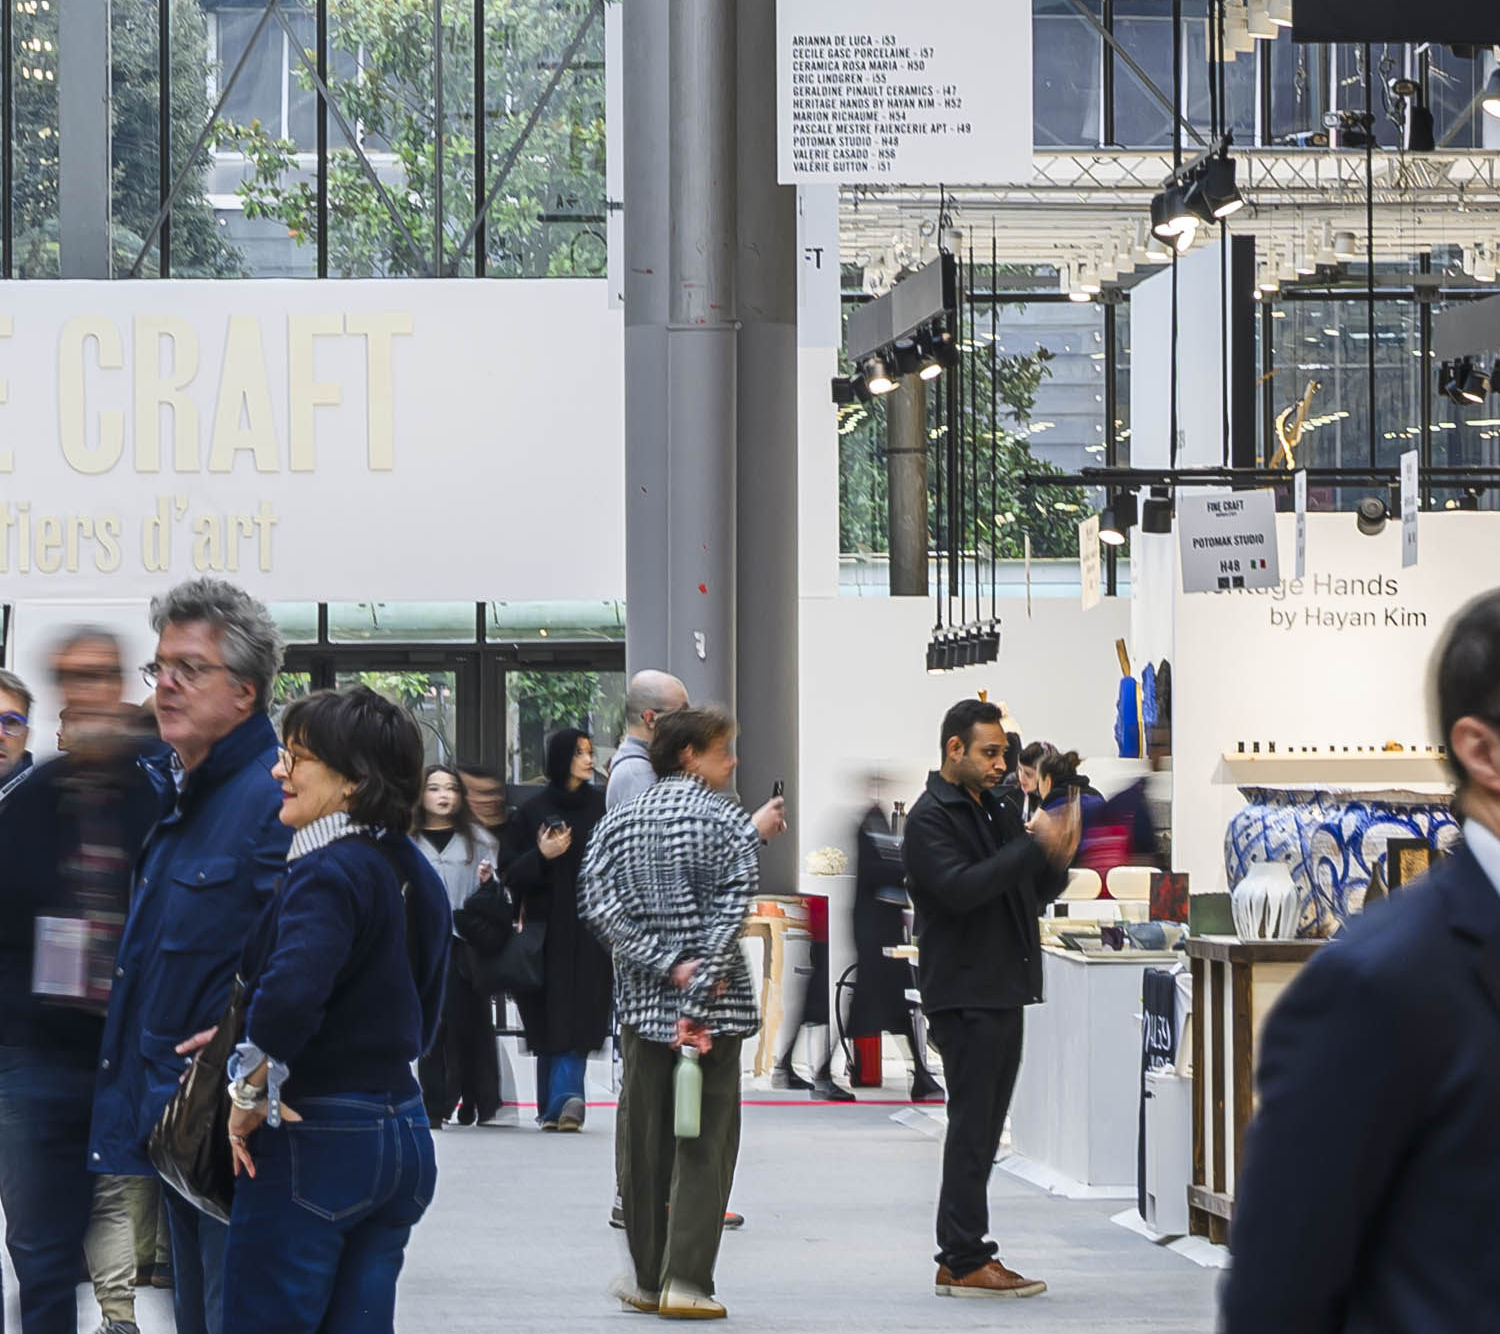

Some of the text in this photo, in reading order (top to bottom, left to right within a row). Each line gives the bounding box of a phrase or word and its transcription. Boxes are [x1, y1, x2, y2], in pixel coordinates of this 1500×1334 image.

[56, 313, 413, 474] CRAFT
[142, 494, 278, 574] d'art
[1192, 533, 1265, 549] POTOMAK STUDIO
[1314, 573, 1398, 596] Hands
[1270, 607, 1427, 631] by Hayan Kim
